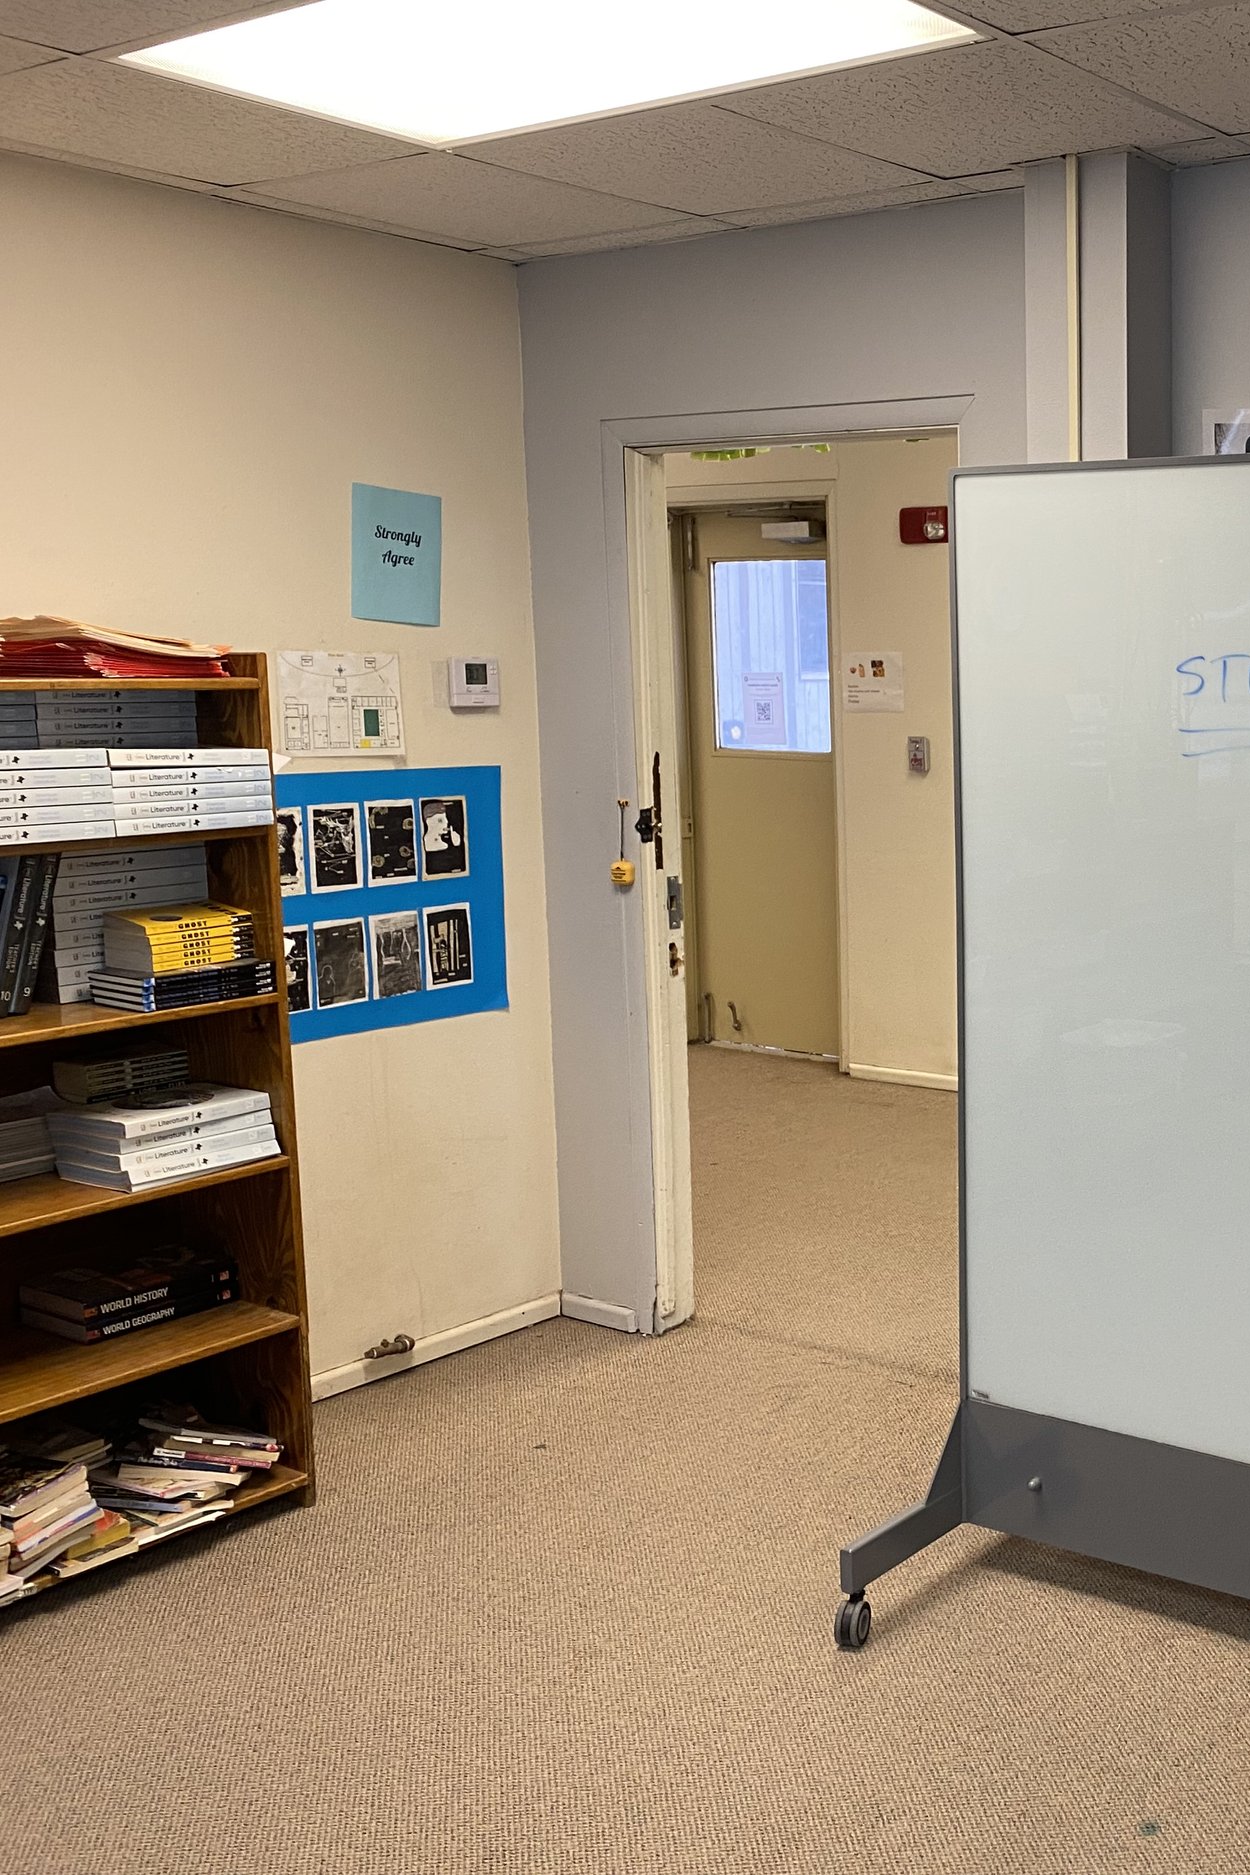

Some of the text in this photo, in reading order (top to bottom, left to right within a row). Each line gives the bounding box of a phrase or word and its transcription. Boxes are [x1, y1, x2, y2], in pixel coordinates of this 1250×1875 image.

[374, 525, 422, 547] Strongly
[382, 550, 415, 567] Agree
[145, 753, 181, 761] Literature
[148, 773, 183, 781] Literature
[150, 789, 184, 797] Literature
[150, 805, 185, 813] Literature
[152, 821, 187, 829] Literature
[178, 921, 207, 929] GHOST
[181, 931, 210, 939] GHOST
[183, 940, 210, 949] GHOST
[183, 949, 211, 957] GHOST
[184, 957, 212, 966] GHOST
[0, 990, 11, 1001] 10
[23, 987, 31, 997] 9
[157, 1115, 190, 1128] Literature
[153, 1130, 186, 1143] Literature
[154, 1147, 188, 1159] Literature
[161, 1161, 195, 1173] Literature
[100, 1287, 169, 1314] WORLD HISTORY
[102, 1307, 176, 1335] WORLD GEOGRAPHY
